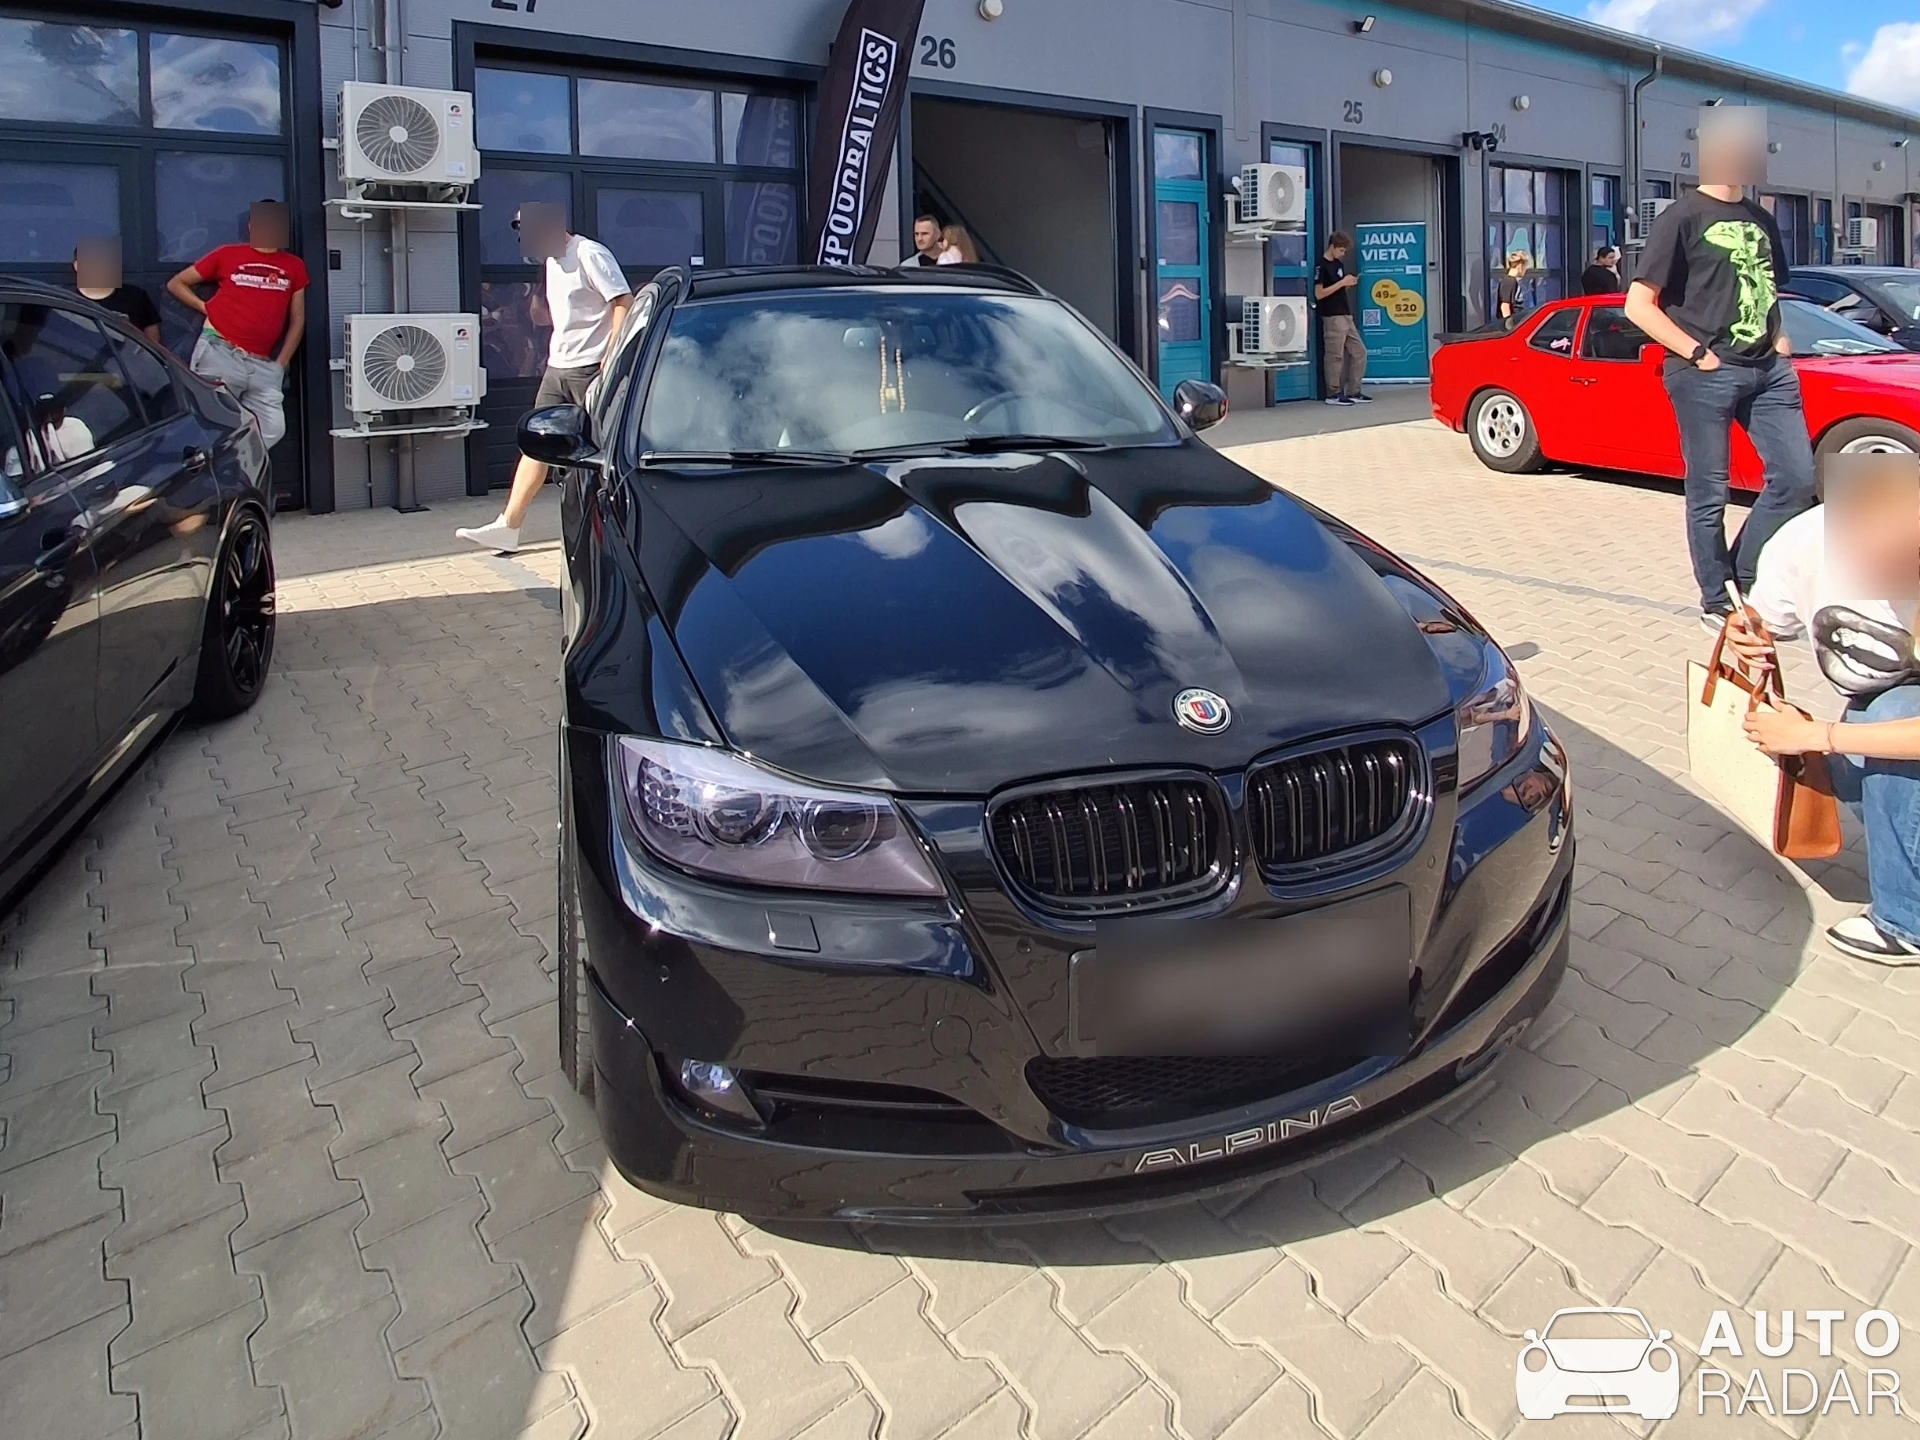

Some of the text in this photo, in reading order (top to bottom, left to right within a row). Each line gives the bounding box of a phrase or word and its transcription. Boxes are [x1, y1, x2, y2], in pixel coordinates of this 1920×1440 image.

[920, 35, 956, 69] 26
[1343, 99, 1363, 124] 25
[1361, 232, 1417, 246] JAUNA
[1361, 248, 1409, 261] VIETA
[1375, 291, 1389, 299] 49
[1134, 1095, 1361, 1173] ALPINA
